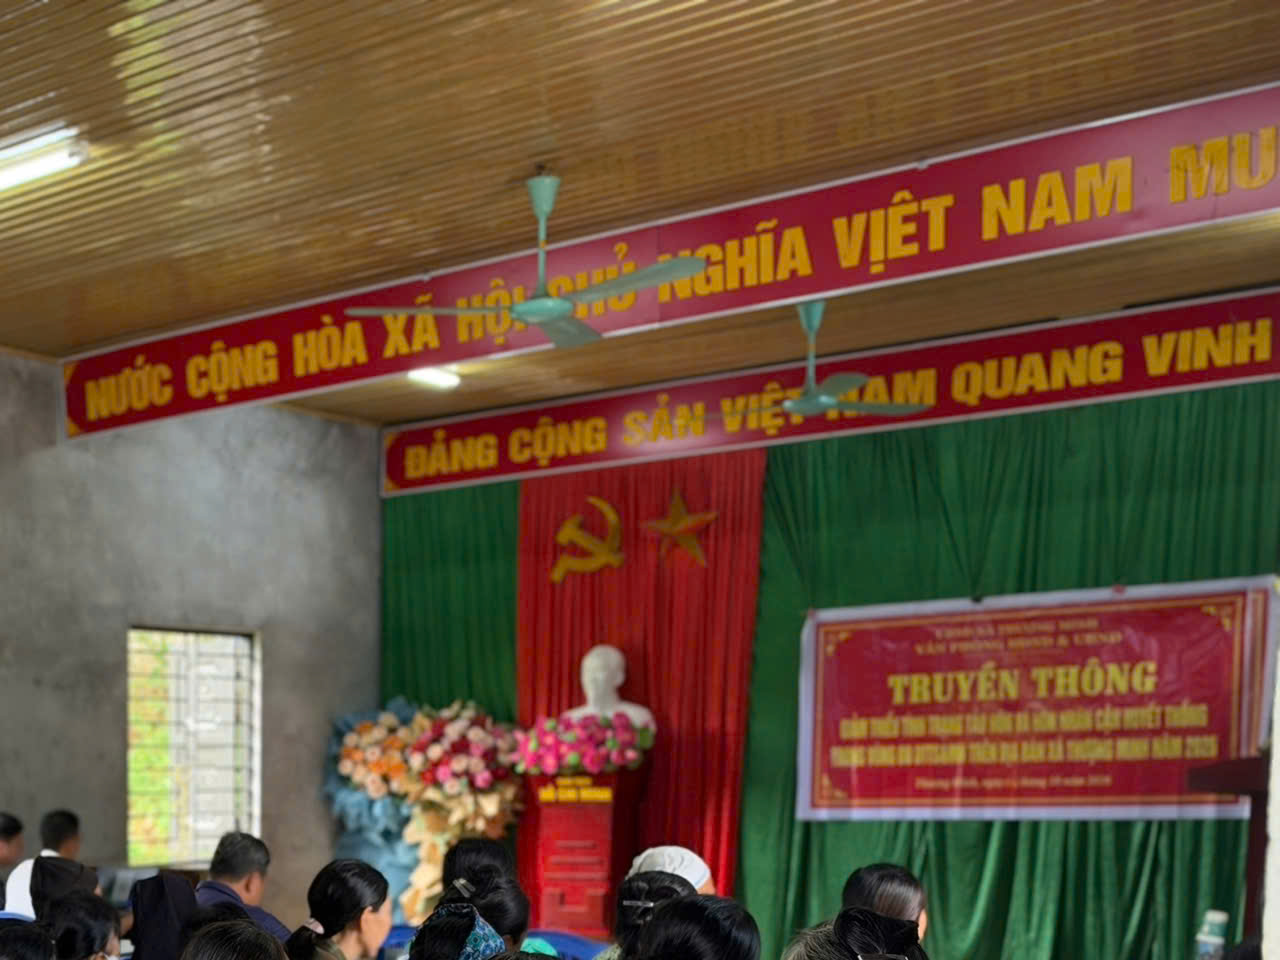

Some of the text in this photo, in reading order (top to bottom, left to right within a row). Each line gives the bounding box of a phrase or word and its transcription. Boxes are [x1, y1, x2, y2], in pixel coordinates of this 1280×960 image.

[85, 354, 173, 422] NƯỚC
[186, 340, 278, 402] CỘNG
[292, 315, 368, 377] HÒA
[382, 292, 441, 359] XÃ
[657, 218, 812, 303] NGHĨA
[833, 189, 954, 274] VIỆT
[981, 156, 1133, 241] NAM
[1170, 127, 1277, 204] MU
[404, 428, 498, 479] ĐẢNG
[508, 417, 607, 467] CỘNG
[622, 392, 705, 446] SẢN
[951, 341, 1124, 407] QUANG
[1142, 318, 1272, 377] VINH
[888, 656, 1157, 704] TRUYỀN THÔNG
